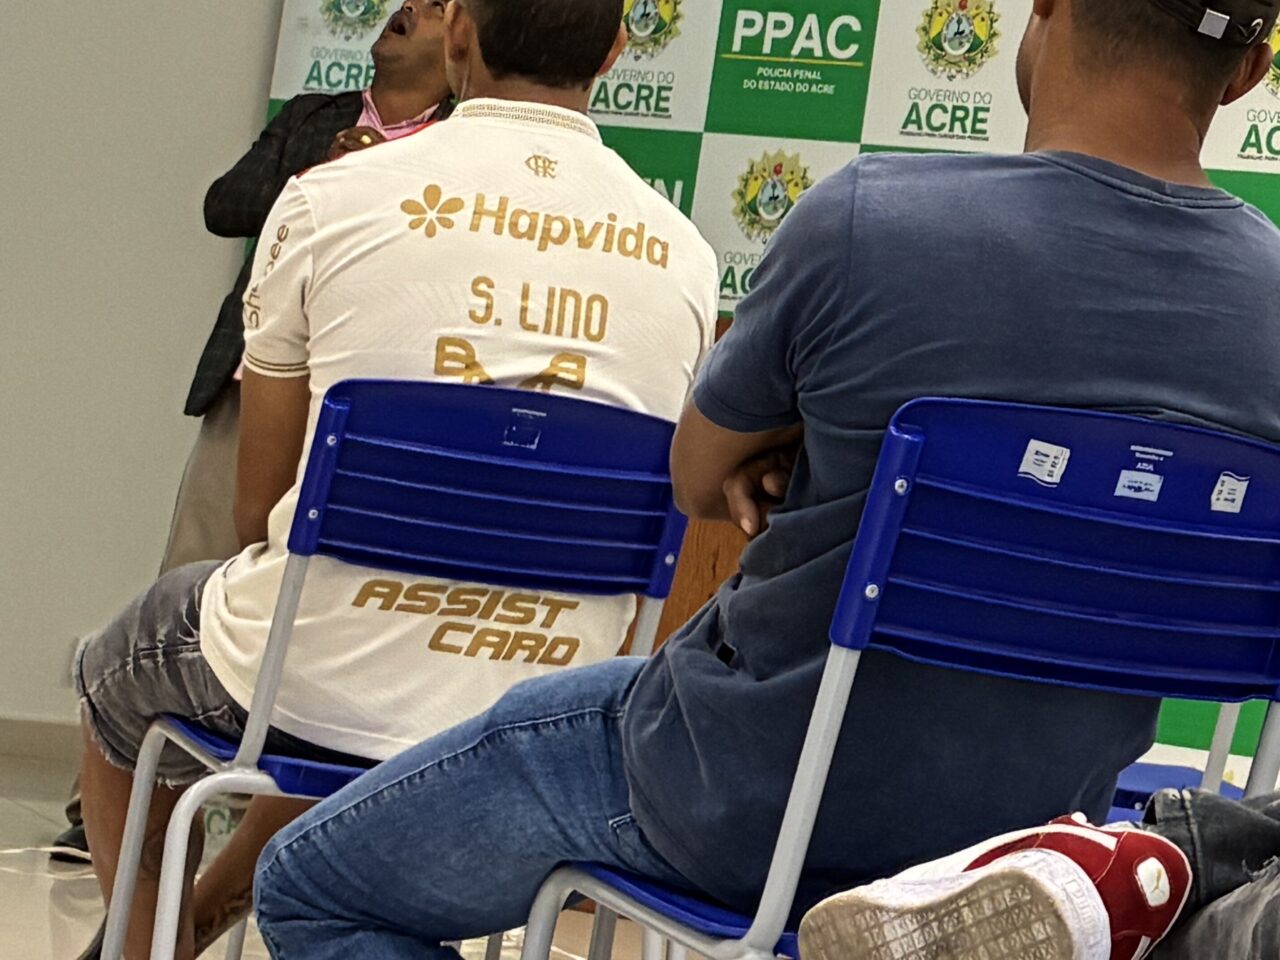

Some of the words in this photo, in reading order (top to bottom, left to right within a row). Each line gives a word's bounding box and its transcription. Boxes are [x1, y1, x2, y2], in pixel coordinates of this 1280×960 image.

[731, 9, 862, 59] PPAC
[311, 46, 364, 61] GOVERNO
[657, 71, 675, 85] DO
[743, 79, 756, 90] DO
[758, 80, 794, 92] ESTADO
[795, 82, 808, 93] DO
[810, 83, 835, 95] ACRE
[793, 68, 821, 80] PENAL
[591, 80, 673, 113] ACRE
[908, 87, 970, 104] GOVERNO
[973, 91, 992, 105] DO
[902, 102, 990, 135] ACRE
[469, 192, 670, 269] Hapvida
[468, 275, 502, 326] S.
[519, 281, 609, 342] LINO
[351, 578, 580, 628] ASSIST
[428, 621, 580, 666] CARD
